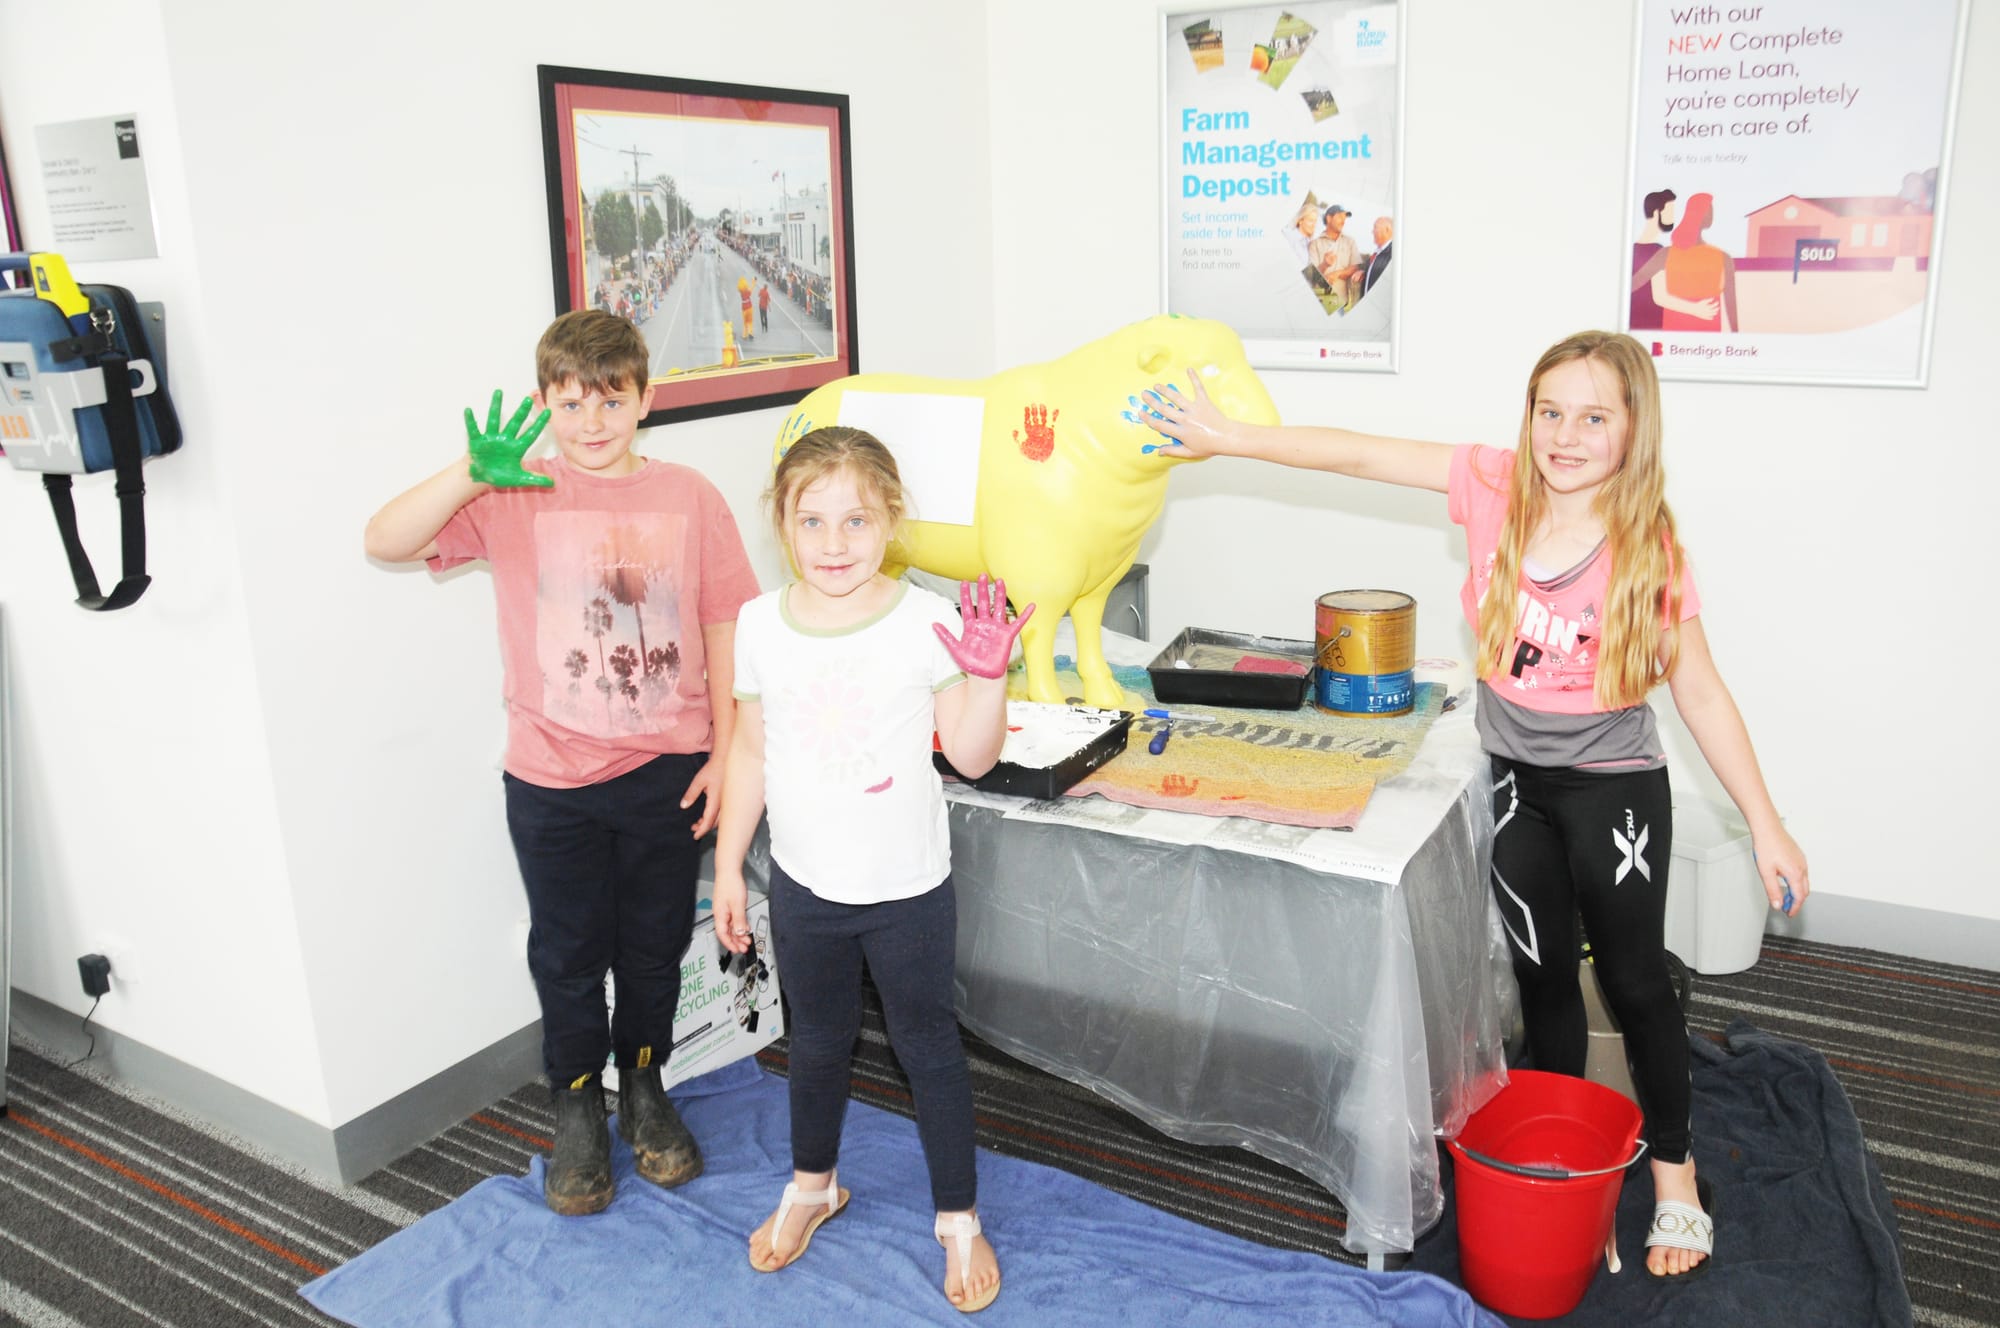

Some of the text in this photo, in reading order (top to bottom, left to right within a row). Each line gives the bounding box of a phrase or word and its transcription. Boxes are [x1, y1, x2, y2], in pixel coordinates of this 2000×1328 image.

[1671, 6, 1763, 25] With our
[1668, 26, 1843, 55] NEW Complete
[1667, 60, 1800, 84] Home Loan,
[1664, 84, 1860, 117] you're completely
[1182, 107, 1249, 132] Farm
[1664, 113, 1813, 139] taken care of.
[1182, 134, 1371, 168] Management
[1663, 153, 1683, 165] Talk
[1686, 154, 1697, 164] to
[1182, 171, 1290, 203] Deposit
[1182, 210, 1248, 225] Set income
[1182, 227, 1213, 240] aside
[1217, 226, 1233, 239] for
[1182, 247, 1232, 258] Ask here to
[1800, 246, 1836, 262] SOLD
[1182, 260, 1198, 270] find
[1201, 261, 1214, 270] out
[1330, 350, 1382, 359] Bendigo Bank
[1669, 344, 1758, 358] Bendigo Bank
[680, 955, 706, 979] BILE
[679, 976, 704, 1001] ONE
[673, 980, 730, 1025] ECYCLING
